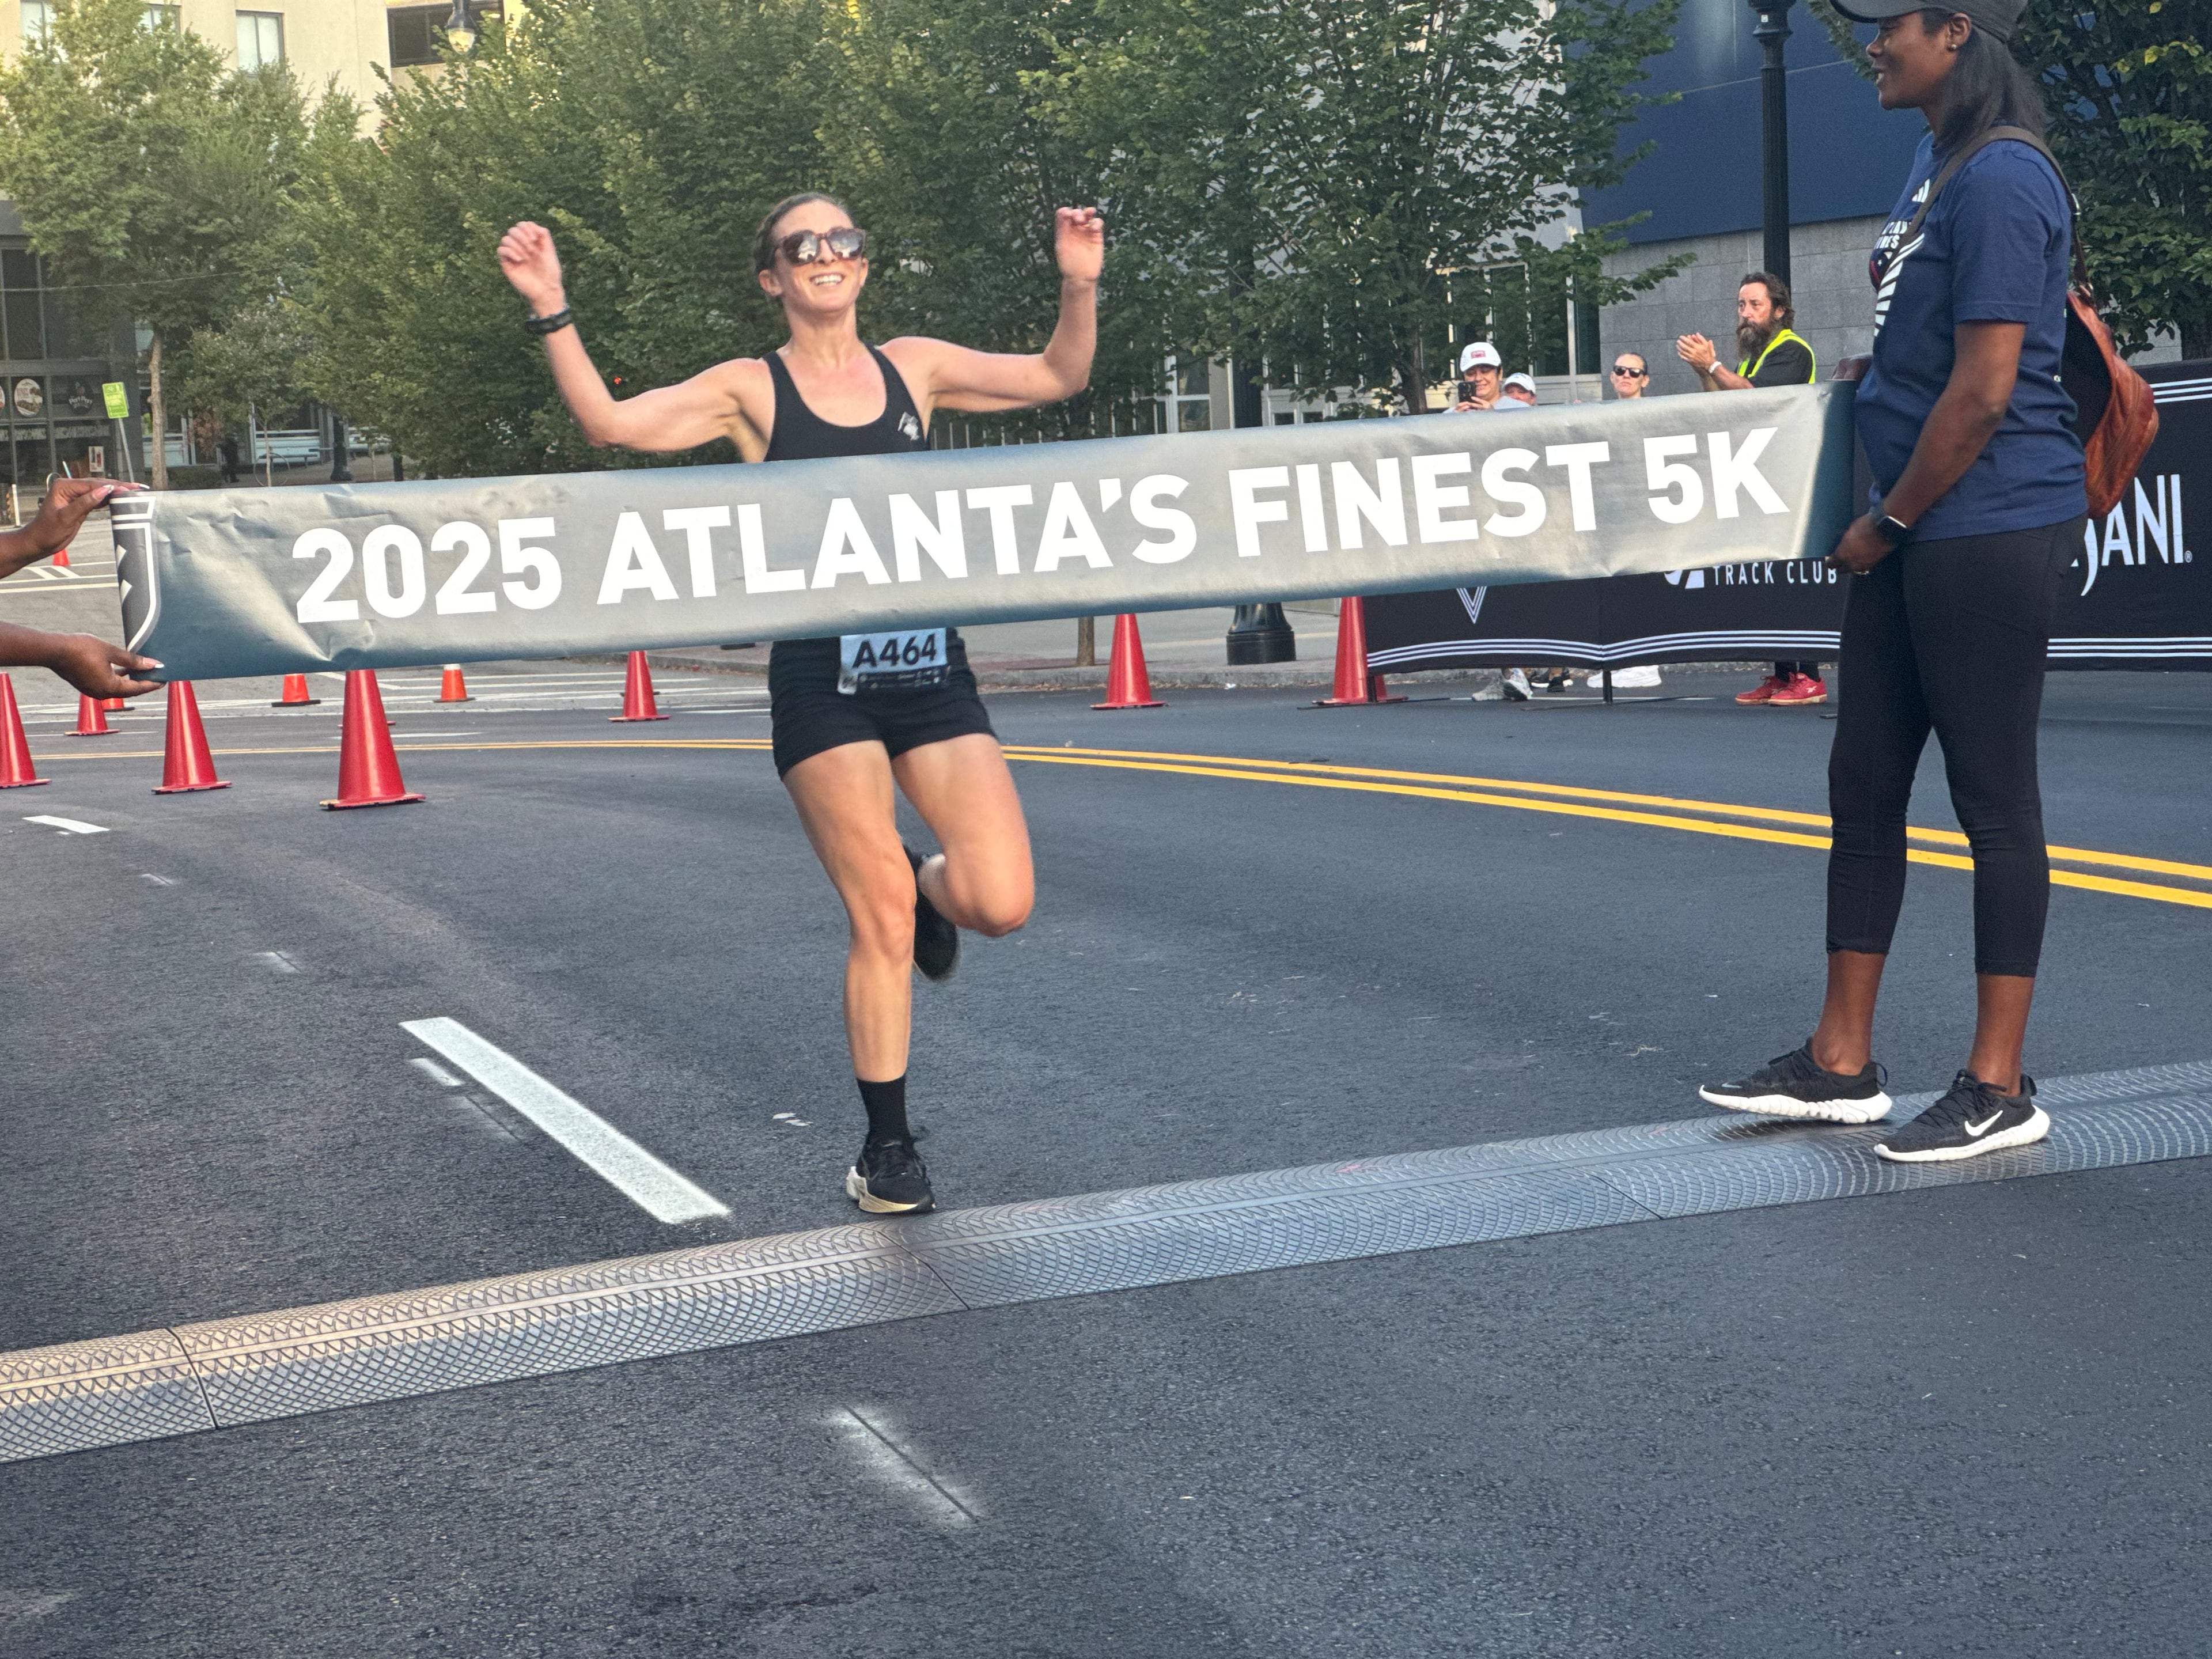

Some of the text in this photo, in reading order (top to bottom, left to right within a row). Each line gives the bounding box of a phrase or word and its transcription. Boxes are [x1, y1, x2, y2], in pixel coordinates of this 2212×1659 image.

[292, 427, 1791, 624] 2025 ATLANTA'S FINEST 5K
[1713, 560, 1837, 586] TRACK CLUB
[851, 633, 937, 668] A464
